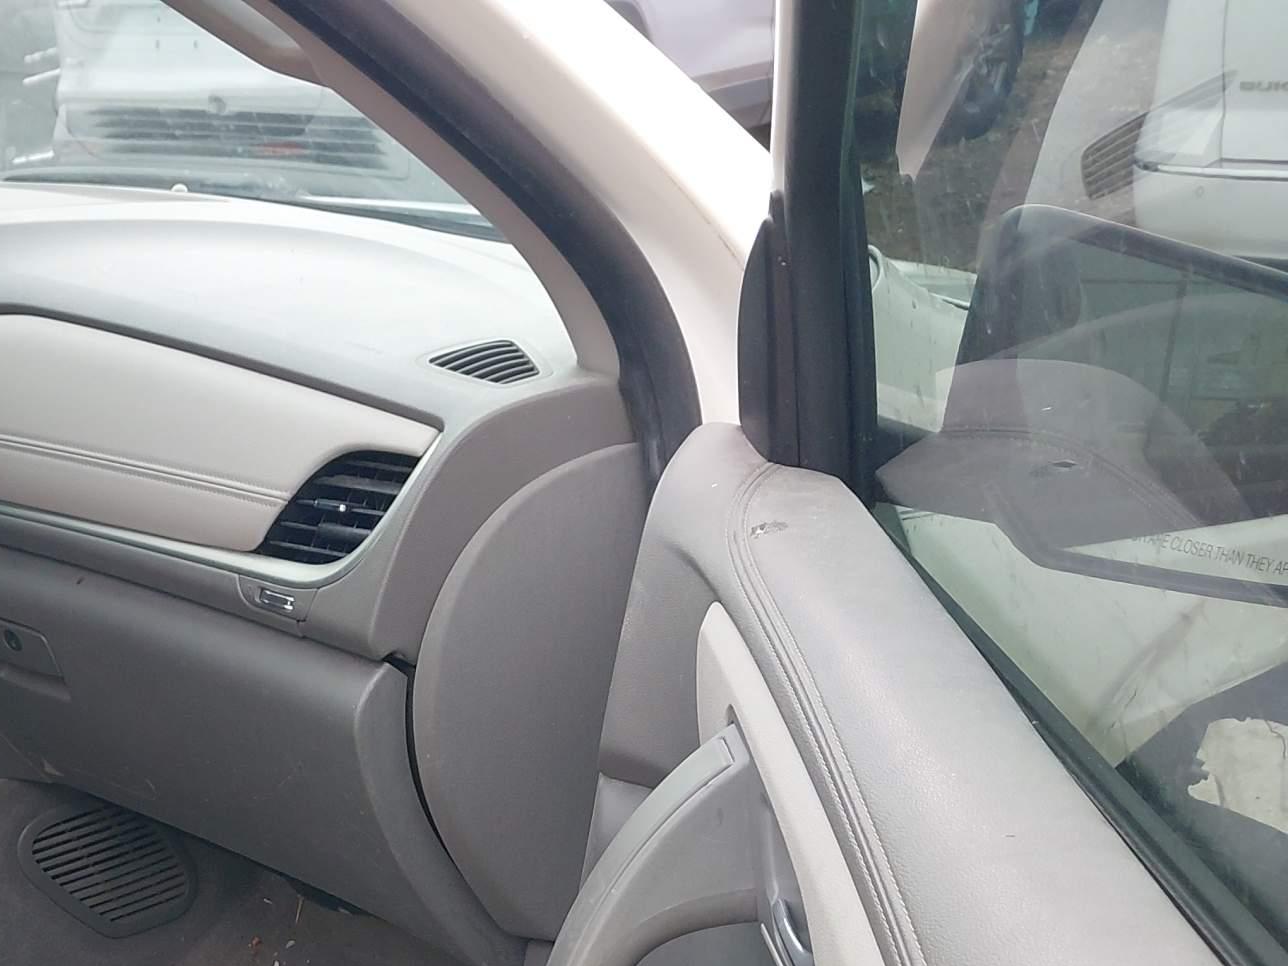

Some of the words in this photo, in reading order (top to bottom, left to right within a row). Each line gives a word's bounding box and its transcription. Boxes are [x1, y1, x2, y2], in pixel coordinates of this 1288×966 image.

[1171, 535, 1213, 560] CLOSER
[1214, 546, 1246, 566] THAN
[1247, 553, 1275, 574] THEY
